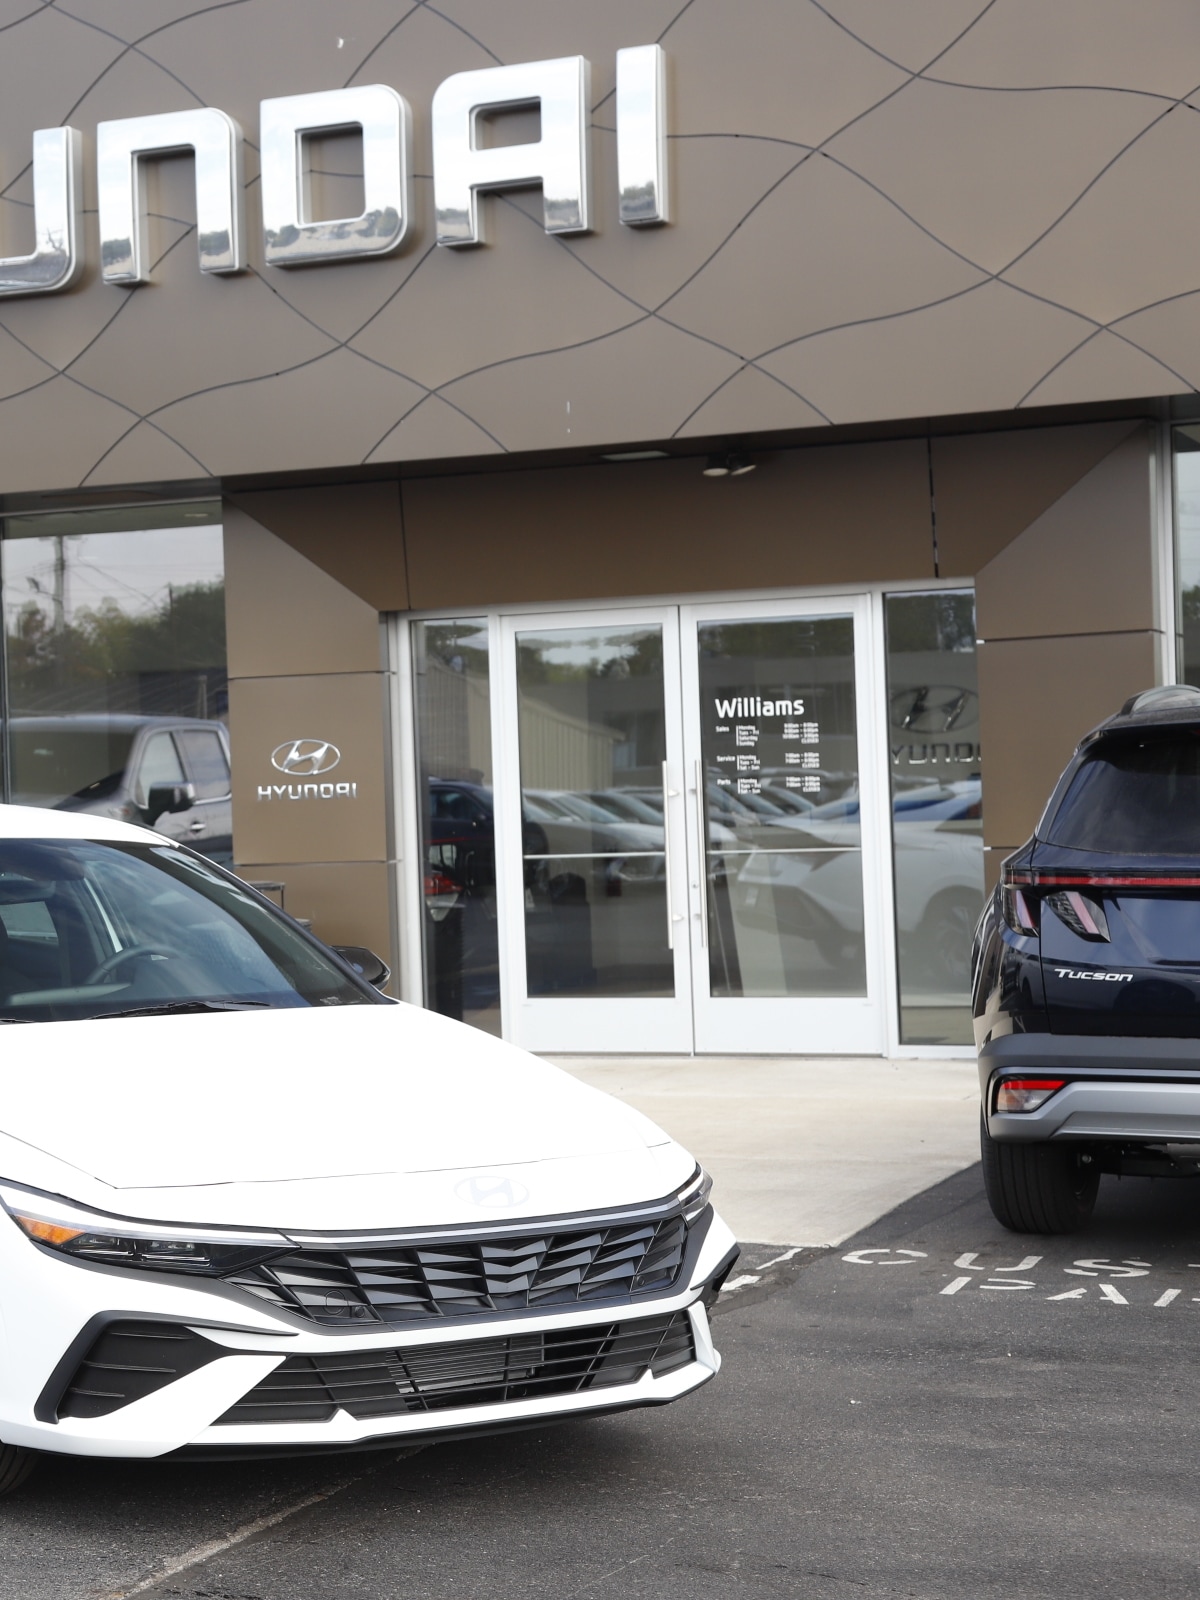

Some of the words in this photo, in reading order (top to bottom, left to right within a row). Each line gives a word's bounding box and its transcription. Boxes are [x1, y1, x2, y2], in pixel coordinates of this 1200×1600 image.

[715, 696, 805, 719] Williams
[258, 783, 356, 801] HYUNDAI
[1054, 968, 1134, 982] Tucson
[841, 1249, 1200, 1278] CUS
